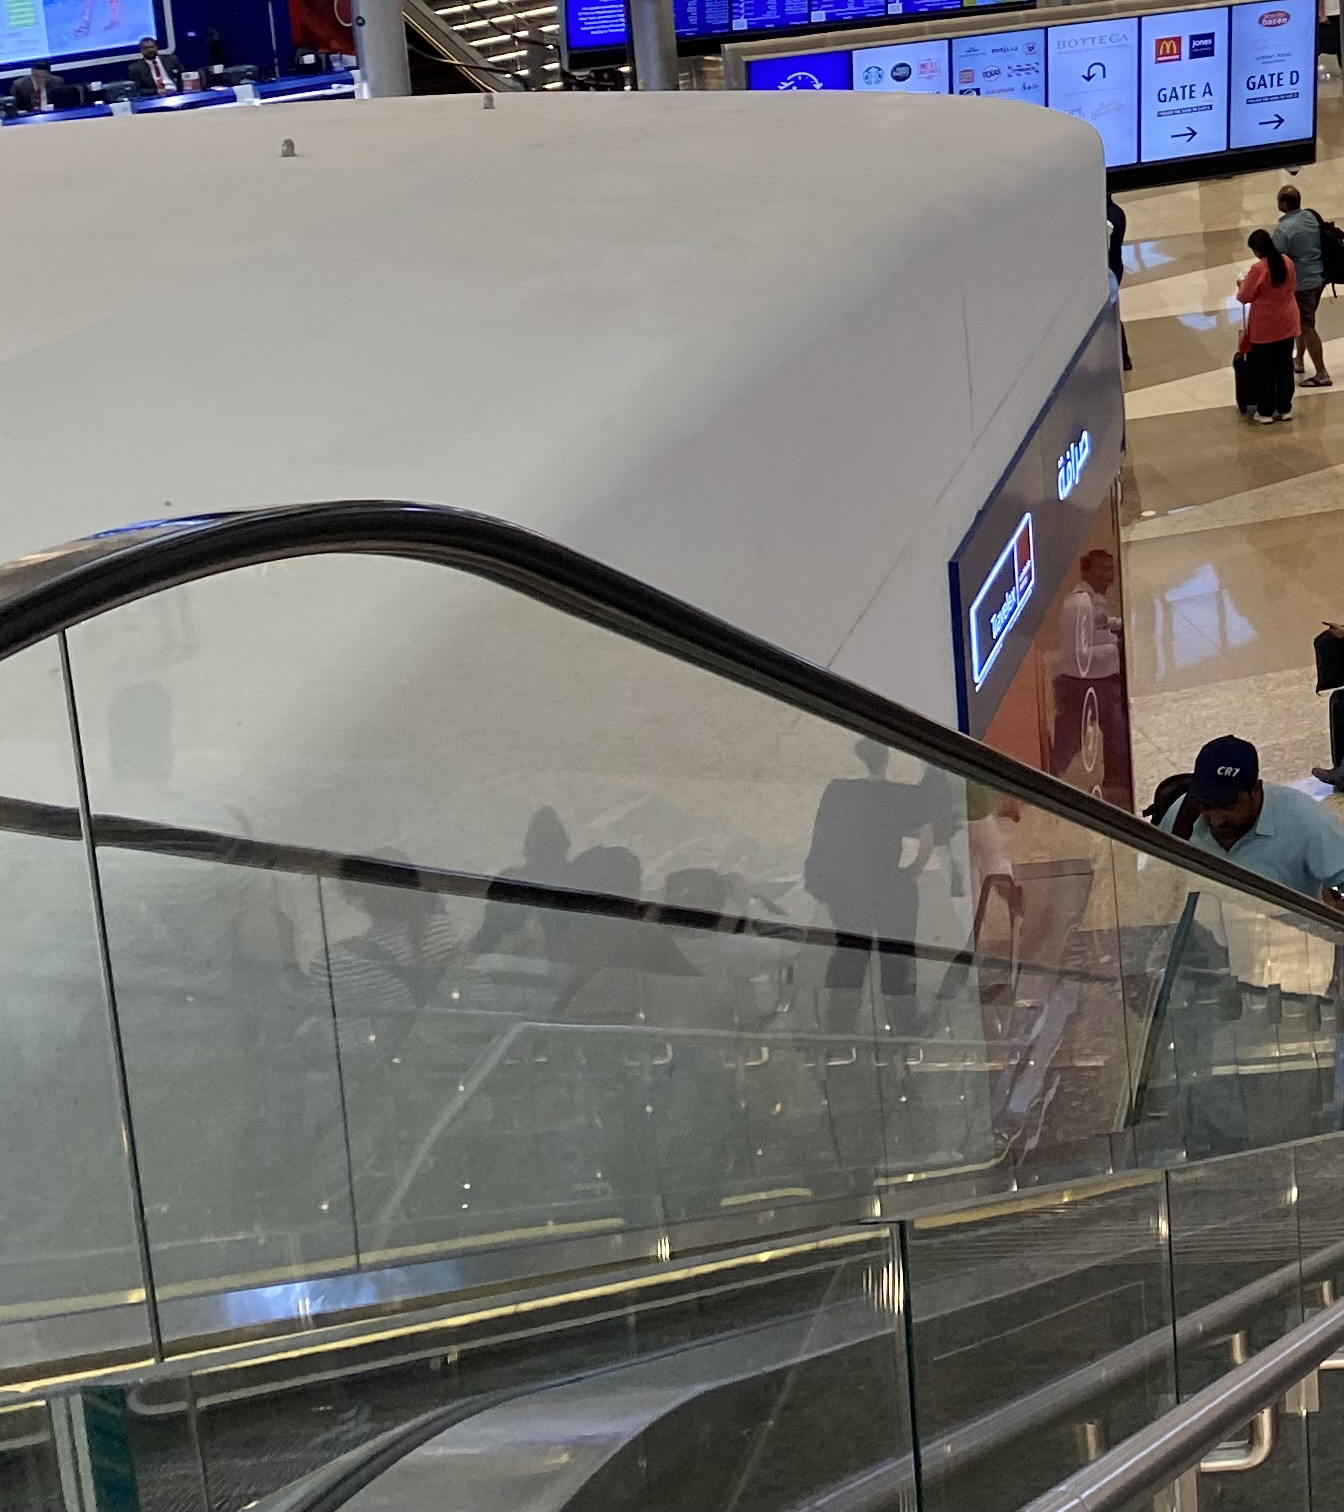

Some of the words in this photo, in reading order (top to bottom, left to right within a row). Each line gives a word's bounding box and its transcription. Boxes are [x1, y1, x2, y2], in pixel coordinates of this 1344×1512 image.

[1057, 34, 1128, 50] BOTTEGA
[1192, 38, 1213, 49] jones
[1246, 71, 1284, 91] GATE
[1290, 70, 1300, 86] D
[1157, 83, 1196, 103] GATE
[1202, 82, 1213, 98] A
[1057, 429, 1091, 501] صرافة
[1217, 766, 1240, 777] CR7
